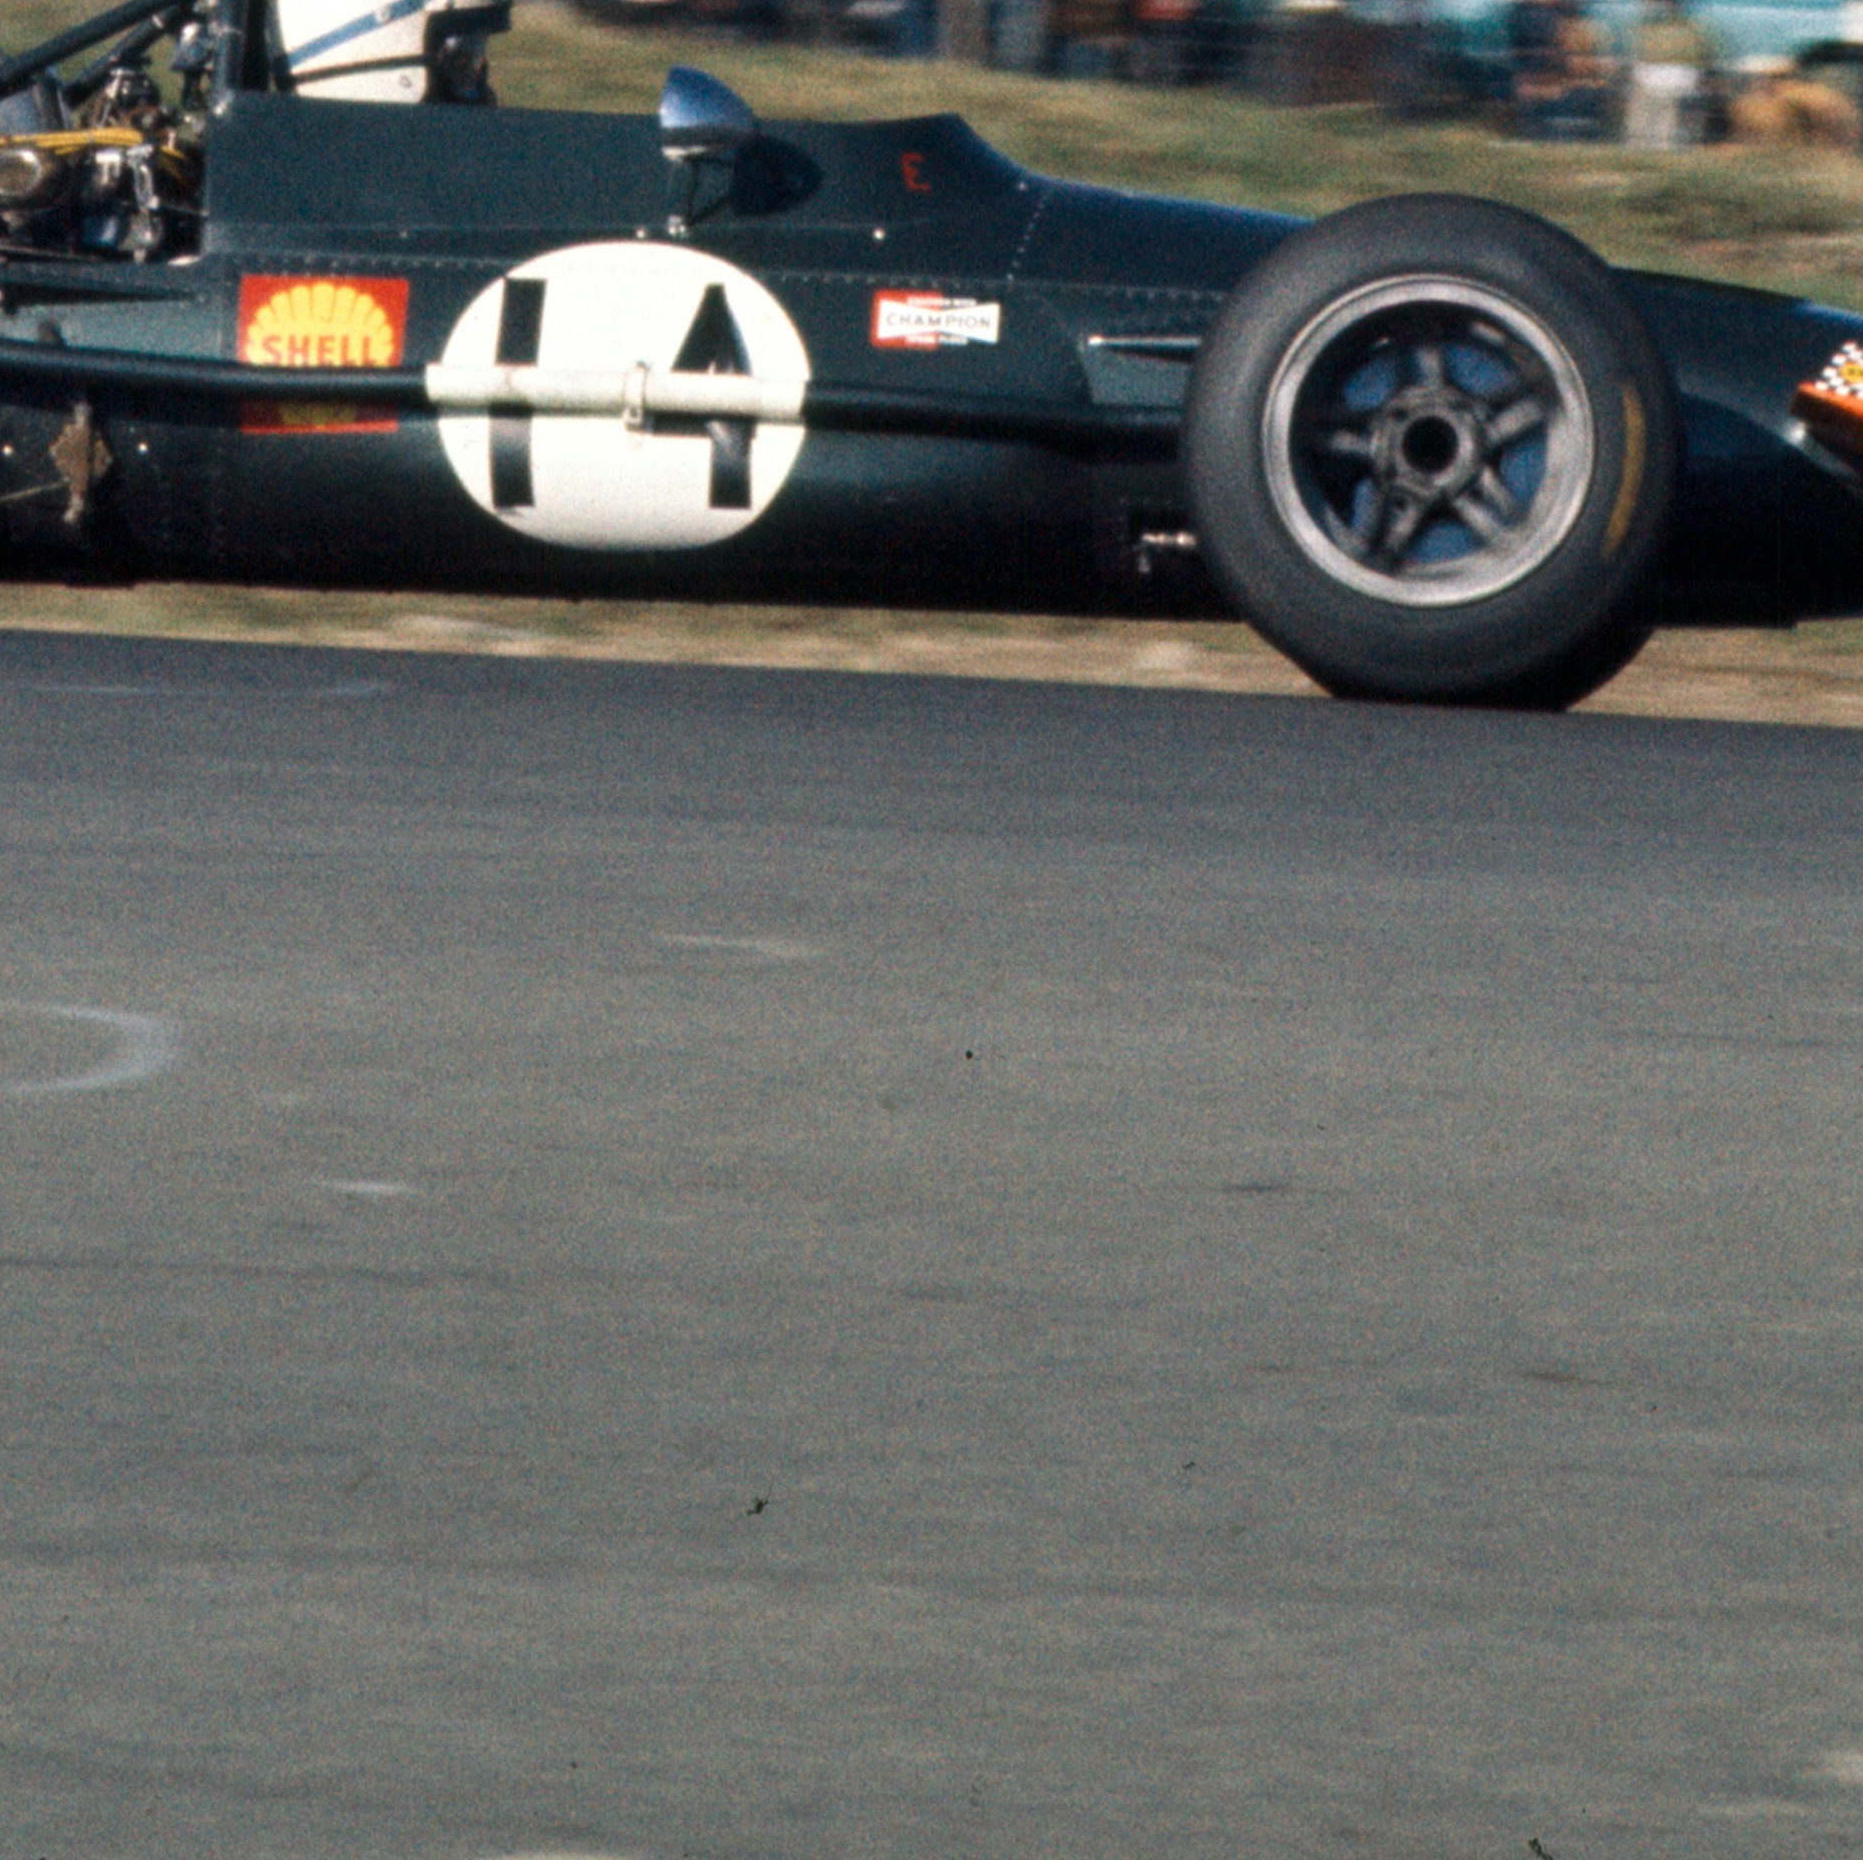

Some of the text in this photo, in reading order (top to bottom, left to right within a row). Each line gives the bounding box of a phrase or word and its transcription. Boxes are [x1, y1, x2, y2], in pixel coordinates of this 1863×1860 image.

[886, 312, 991, 329] CHAMPION
[261, 334, 378, 366] SHELL
[488, 277, 758, 512] 14
